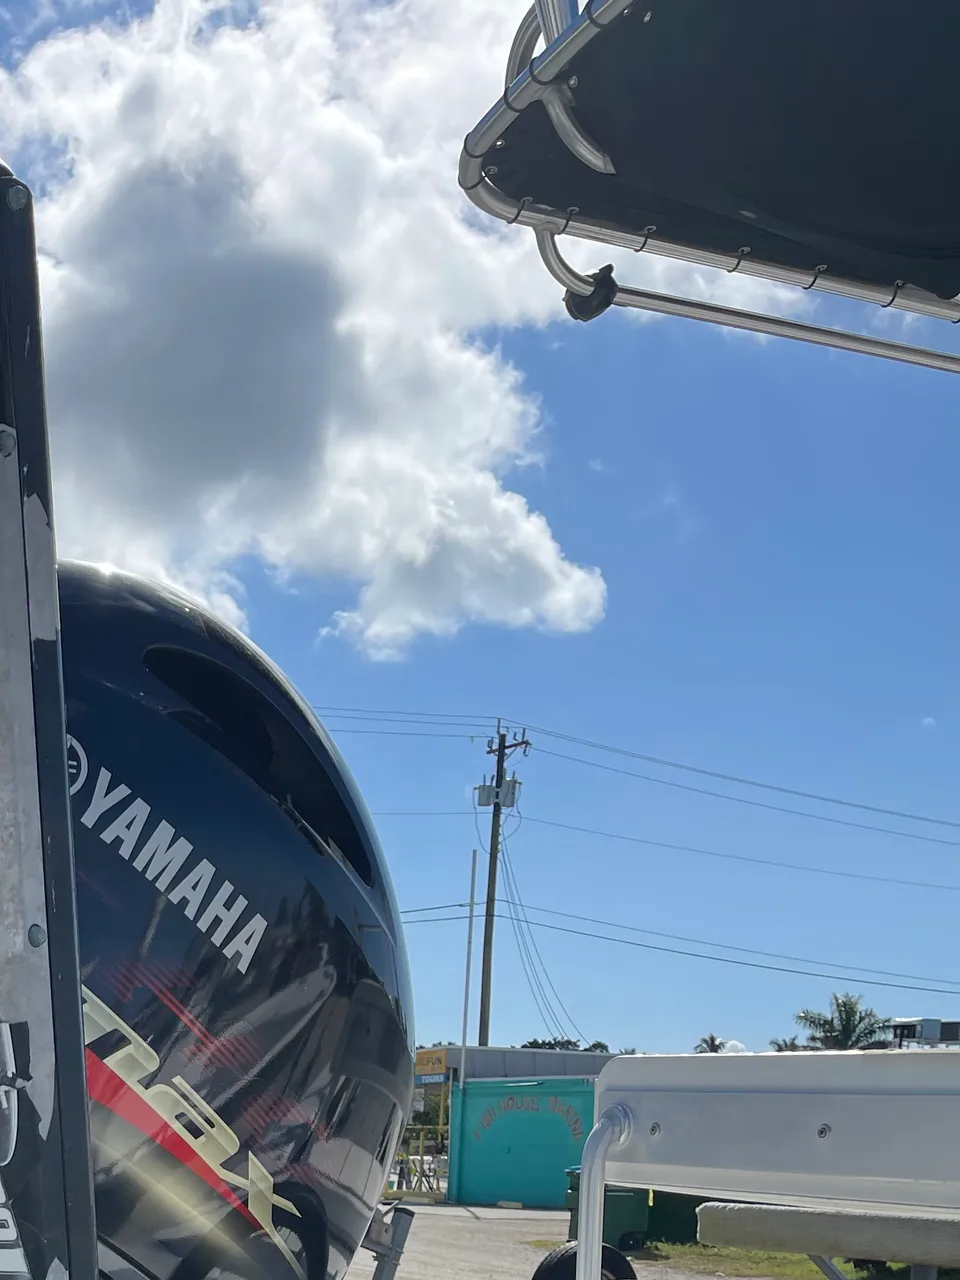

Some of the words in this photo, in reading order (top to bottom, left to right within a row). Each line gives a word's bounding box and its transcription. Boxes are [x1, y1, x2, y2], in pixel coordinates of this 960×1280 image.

[80, 766, 268, 975] YAMAHA
[422, 1074, 444, 1084] TOURS
[497, 1095, 541, 1115] HOUSE
